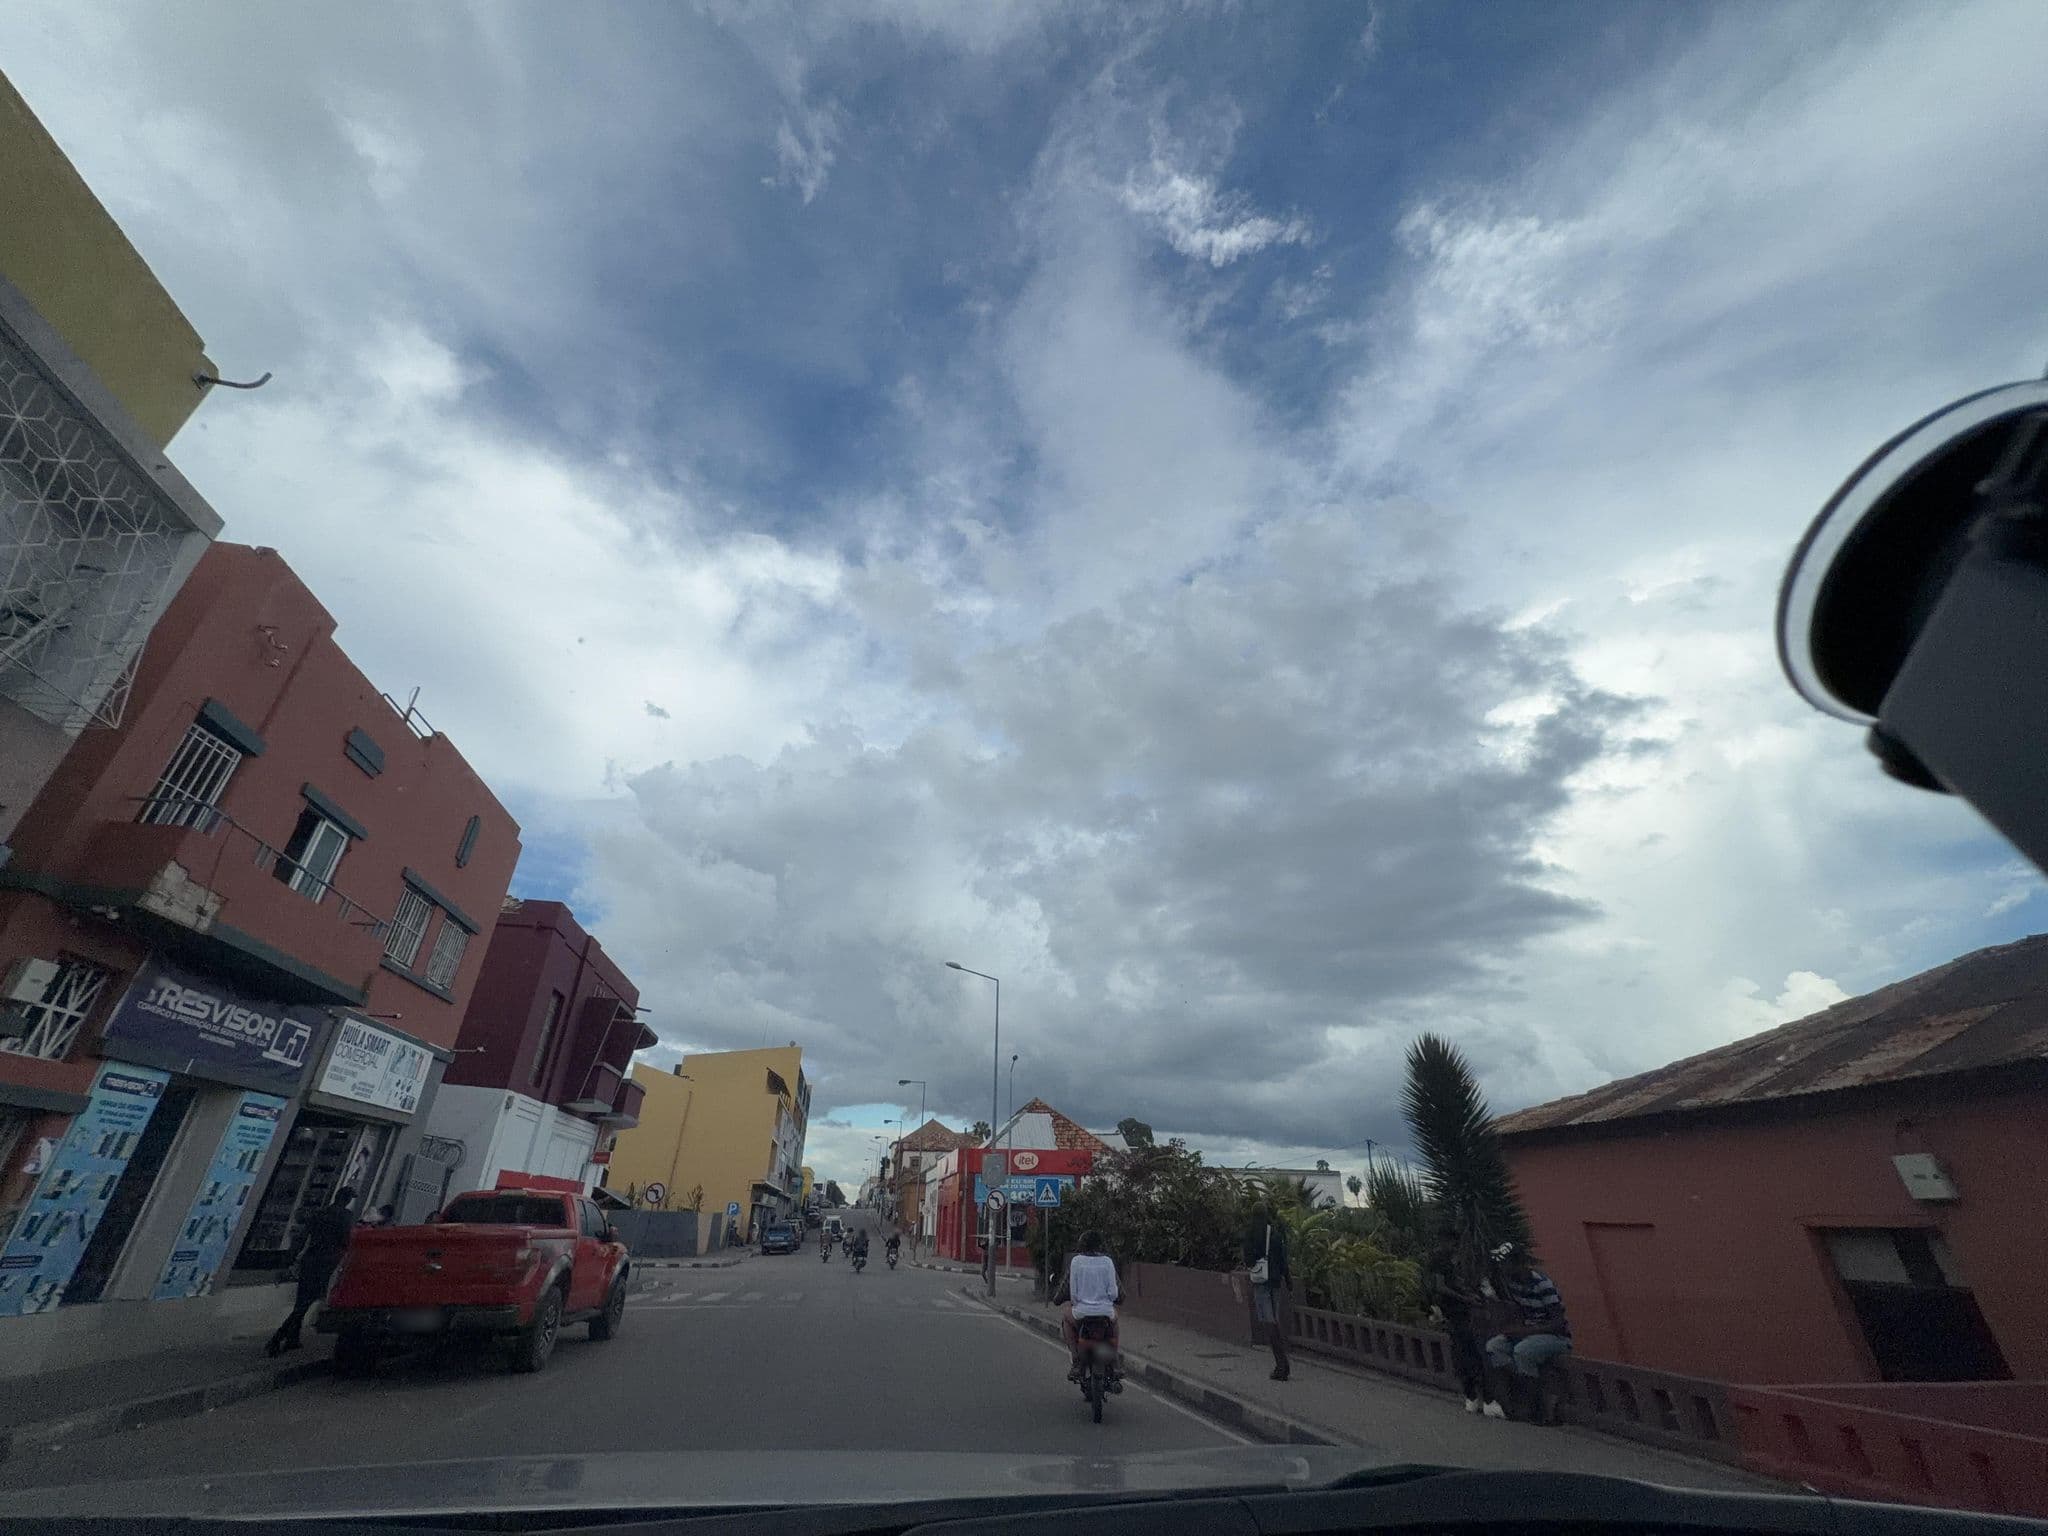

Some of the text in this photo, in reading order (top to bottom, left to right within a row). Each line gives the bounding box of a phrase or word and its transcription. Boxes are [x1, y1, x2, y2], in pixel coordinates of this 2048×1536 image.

[364, 1033, 391, 1057] SMART
[335, 1043, 380, 1069] COMERCIAL
[1018, 1156, 1035, 1166] itel
[729, 1203, 737, 1214] P
